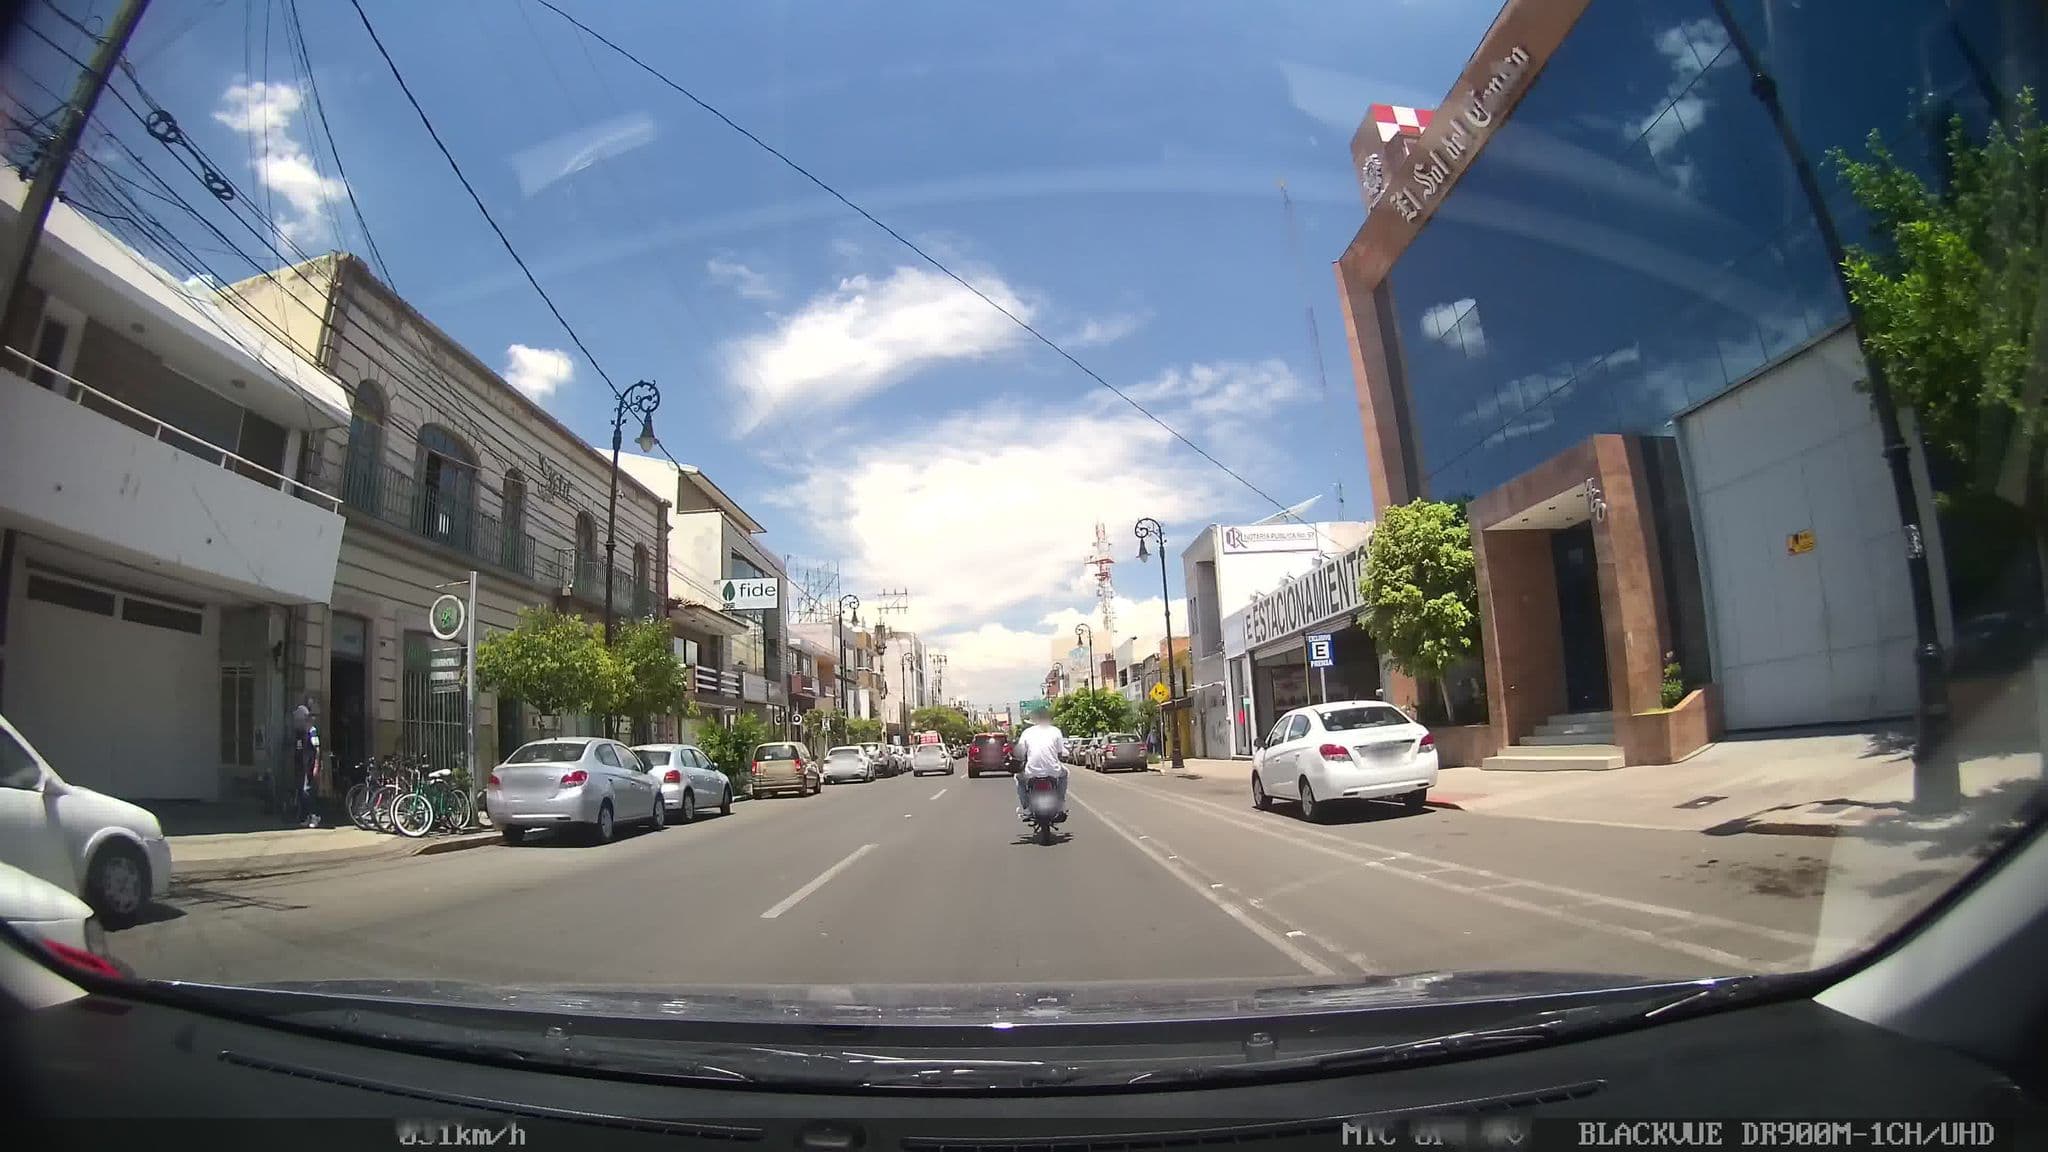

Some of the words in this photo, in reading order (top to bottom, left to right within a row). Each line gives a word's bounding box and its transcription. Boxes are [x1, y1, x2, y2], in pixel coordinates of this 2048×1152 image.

[1389, 187, 1424, 223] El
[1413, 150, 1451, 201] Sol
[739, 582, 776, 598] fide
[1315, 644, 1326, 657] E
